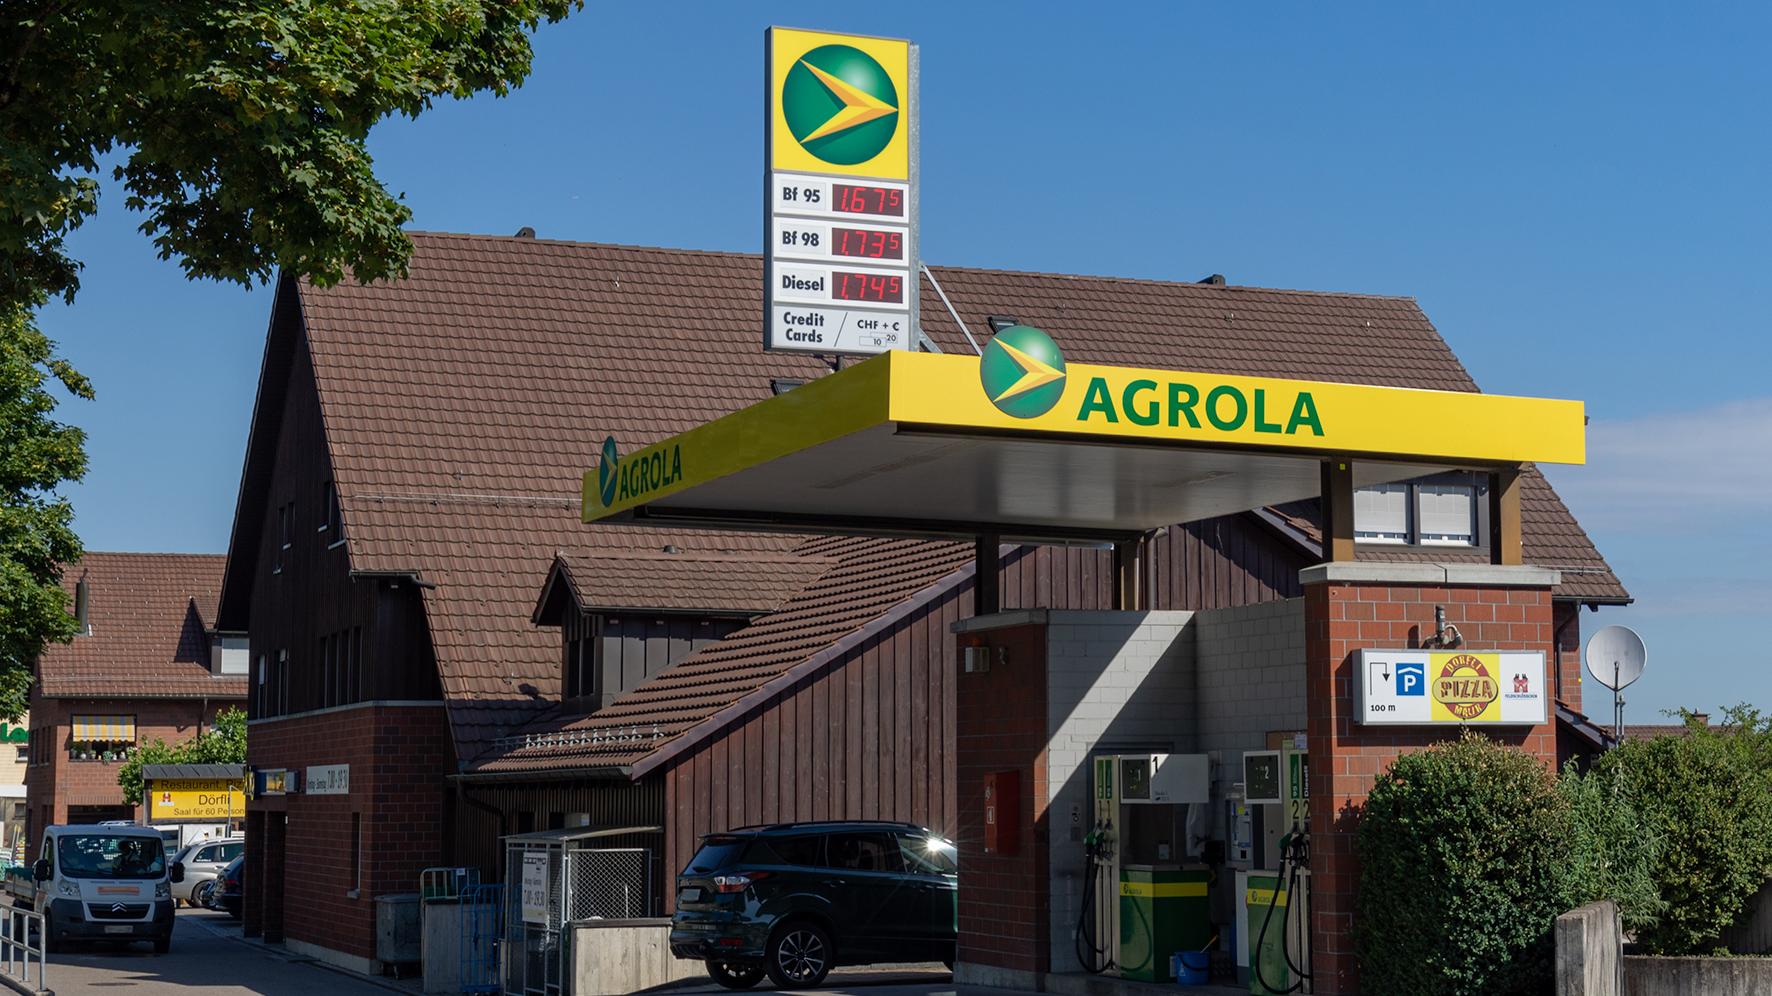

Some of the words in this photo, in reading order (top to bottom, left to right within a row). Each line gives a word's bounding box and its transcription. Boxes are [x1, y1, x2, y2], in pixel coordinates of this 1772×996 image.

[782, 186, 798, 201] Bf
[803, 188, 821, 203] 95
[782, 230, 798, 245] Bf
[801, 232, 819, 247] 98
[782, 274, 824, 291] Diesel
[783, 311, 825, 327] Credit
[857, 319, 878, 330] CHF
[785, 328, 823, 343] Cards
[873, 338, 882, 346] 10
[886, 334, 897, 342] 20
[1076, 376, 1326, 437] AGROLA
[619, 444, 682, 502] AGROLA
[1403, 674, 1417, 693] P
[1440, 679, 1494, 699] PIZZA
[1370, 704, 1386, 712] 100
[1388, 704, 1396, 712] m
[198, 793, 230, 806] Dörfli
[173, 807, 192, 816] Saal
[193, 807, 204, 816] für
[205, 807, 216, 816] 60
[1292, 800, 1300, 820] 2
